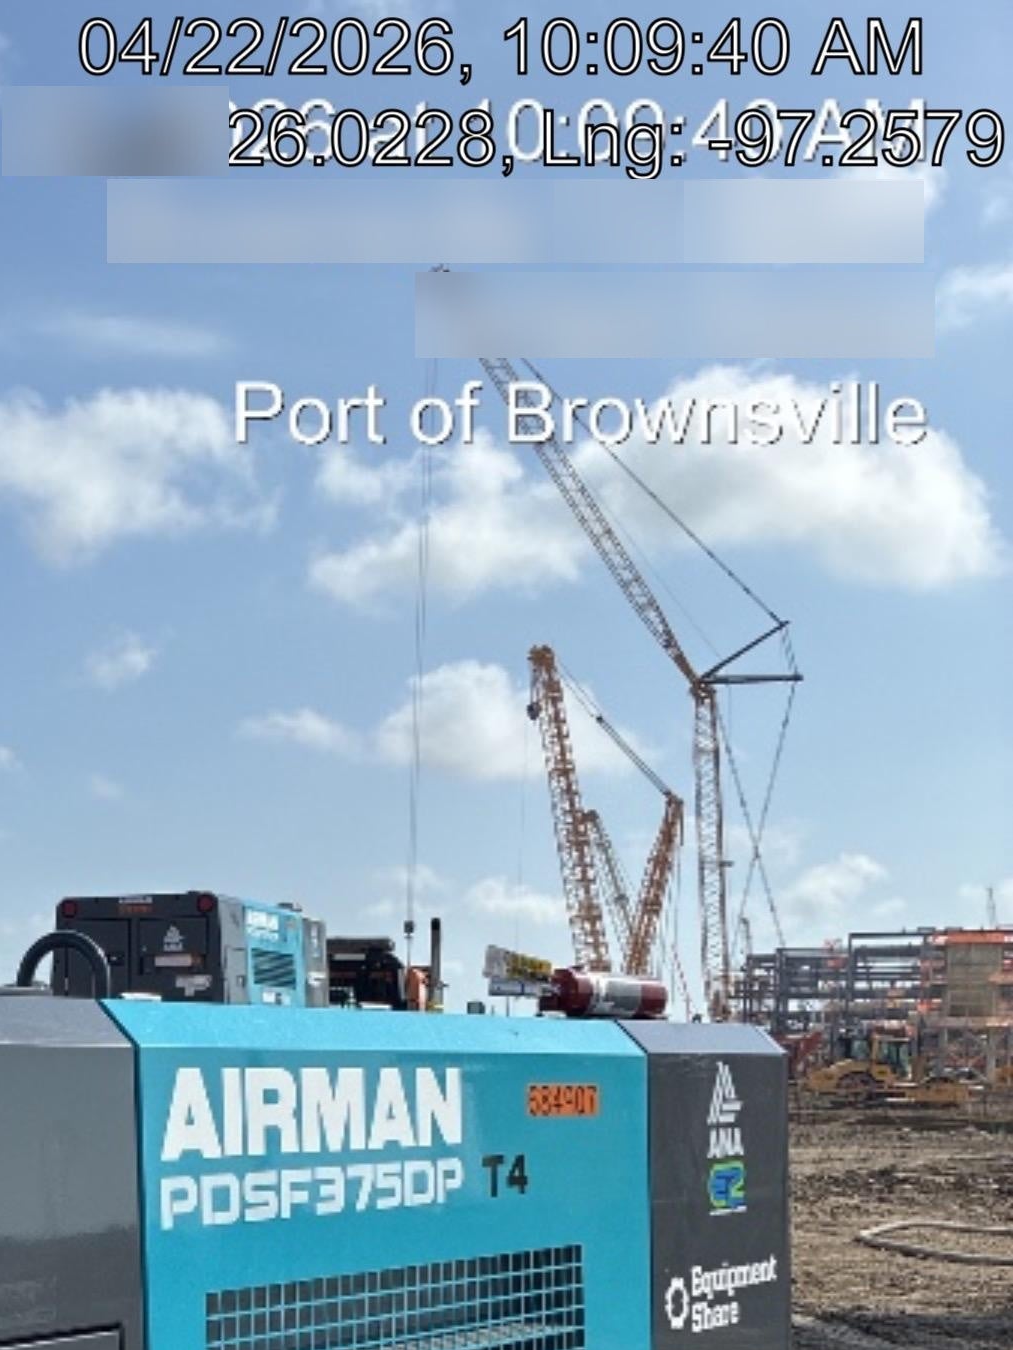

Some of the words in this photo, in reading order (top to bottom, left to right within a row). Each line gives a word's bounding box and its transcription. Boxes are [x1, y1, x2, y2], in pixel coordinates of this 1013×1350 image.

[160, 1067, 462, 1162] AIRMAN
[707, 1127, 744, 1159] ANA
[160, 1157, 464, 1231] PDSF375DP
[482, 1154, 529, 1197] T4
[690, 1253, 777, 1300] Equipment
[691, 1302, 739, 1333] Share
